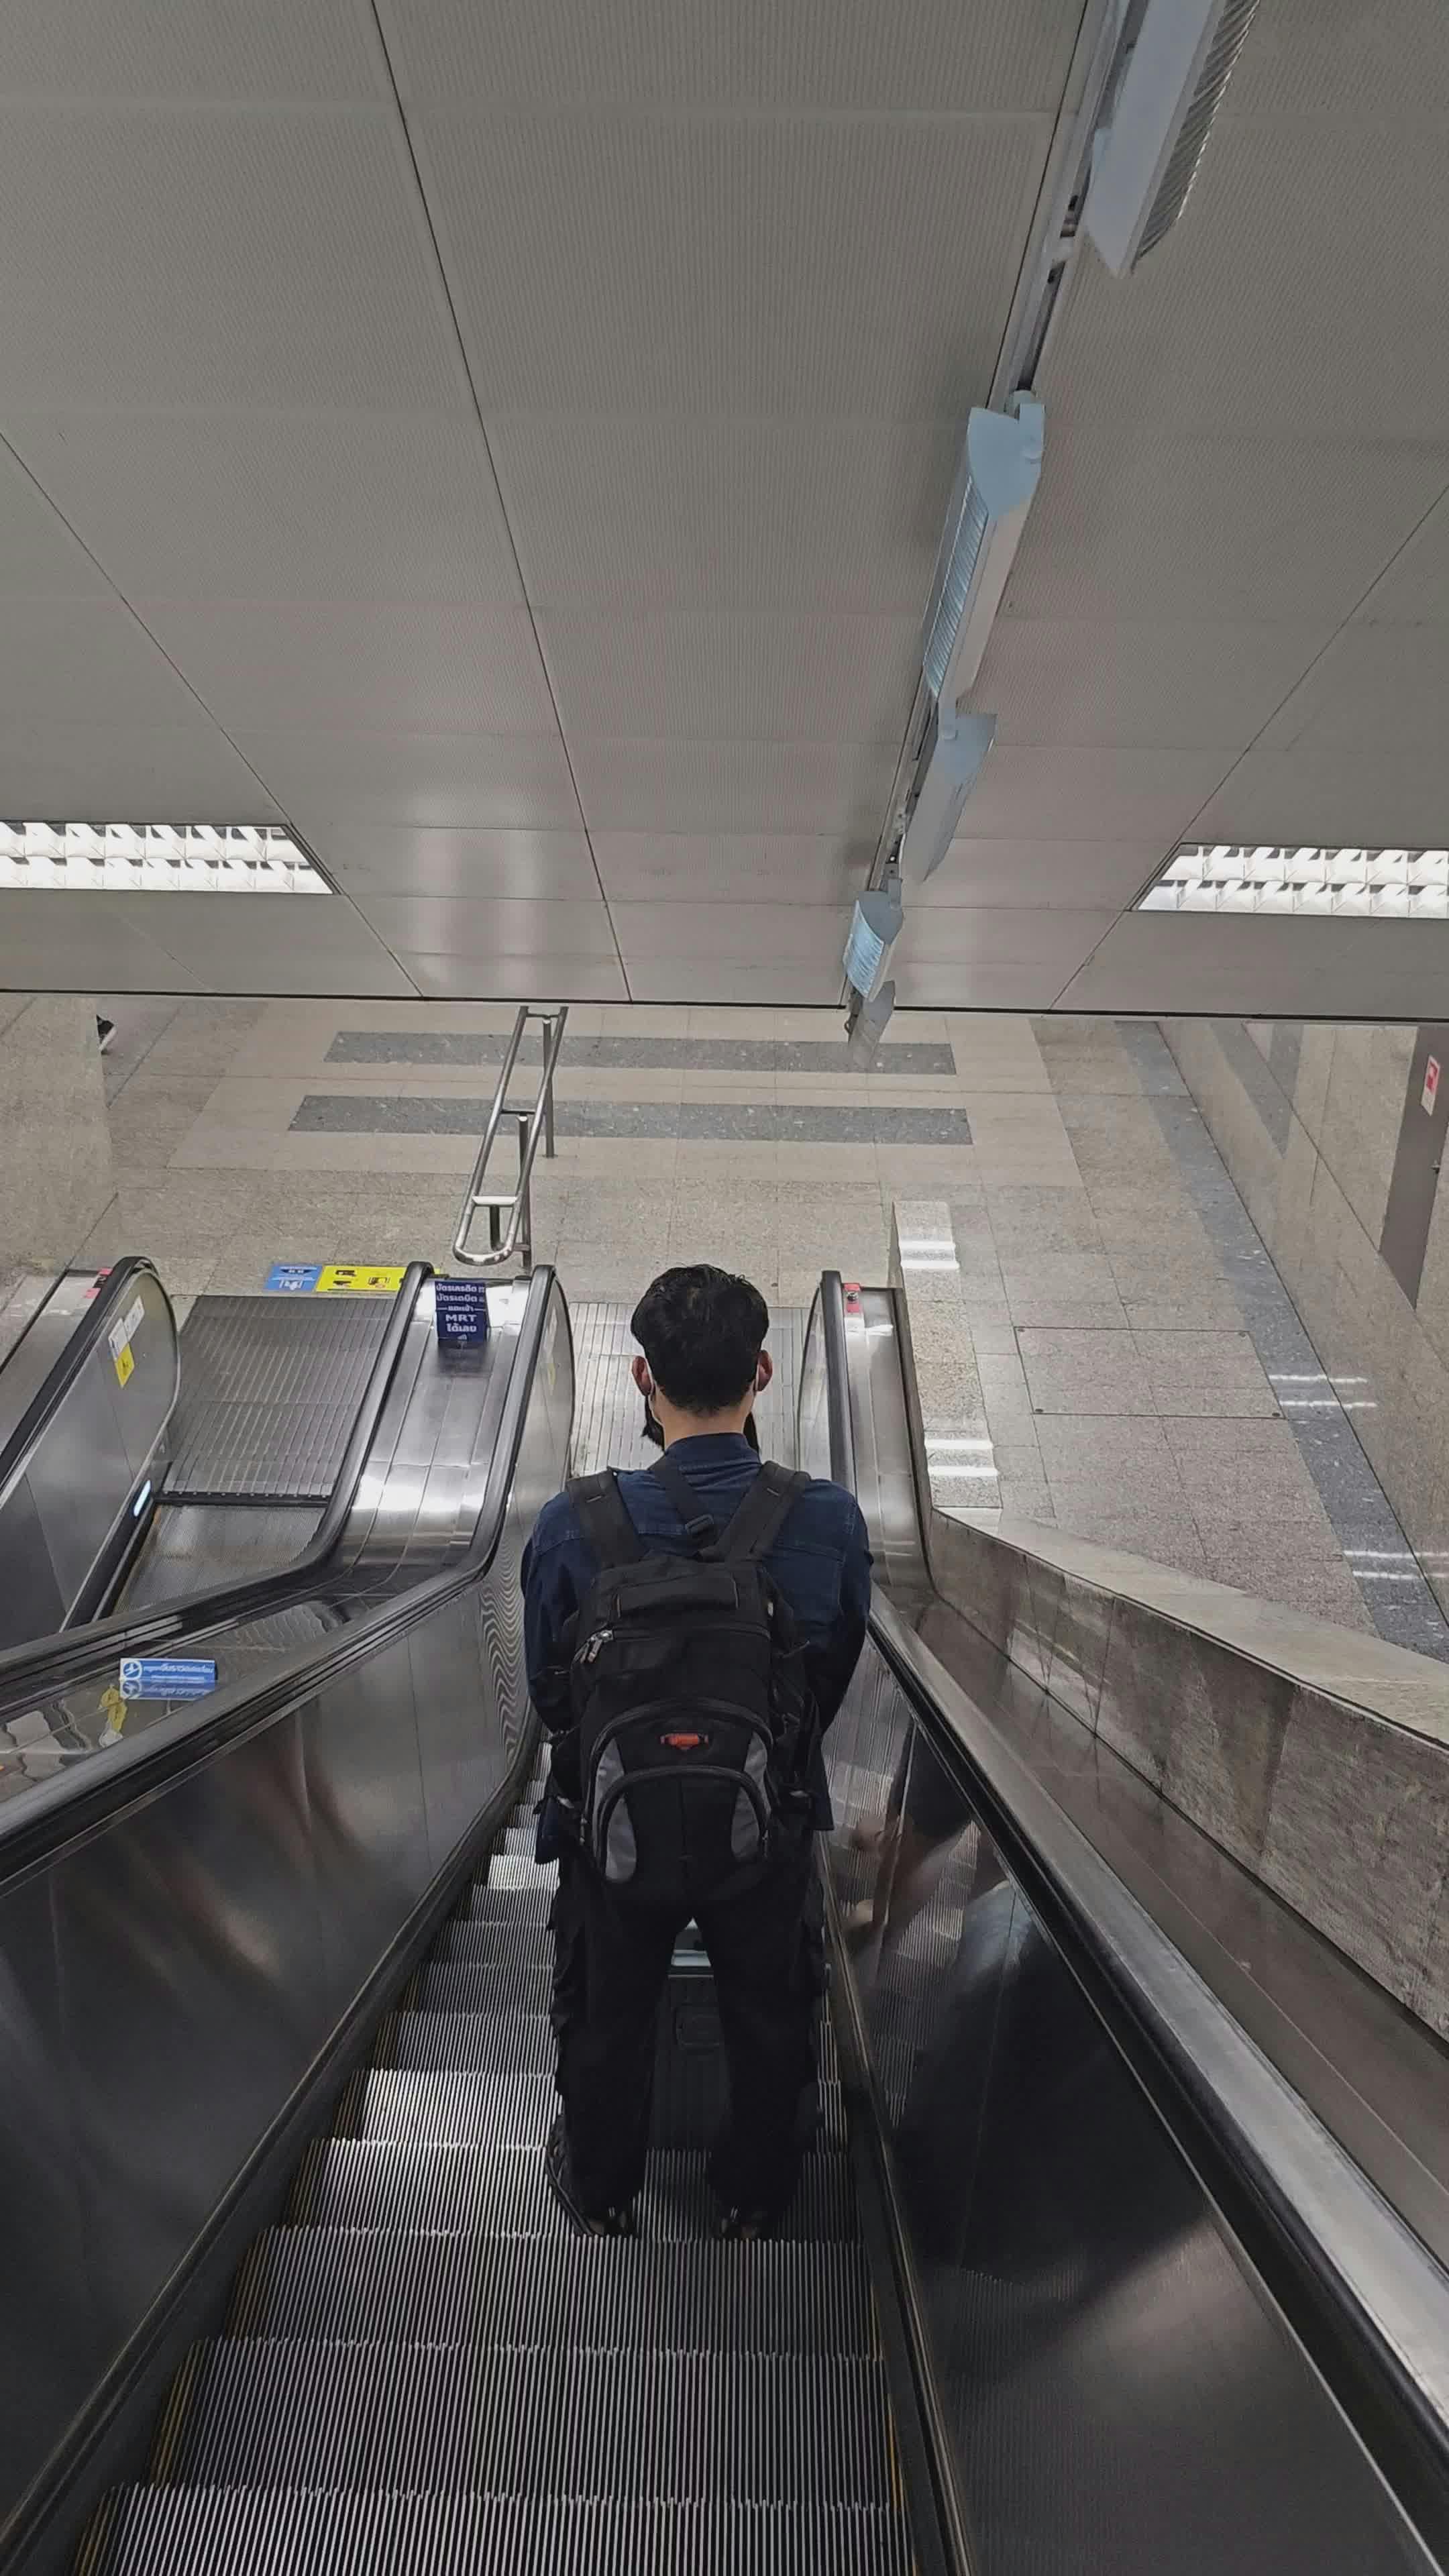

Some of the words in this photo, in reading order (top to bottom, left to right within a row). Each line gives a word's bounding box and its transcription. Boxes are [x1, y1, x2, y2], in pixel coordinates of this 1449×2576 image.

[445, 1314, 477, 1322] MRT
[447, 1323, 477, 1332] ได้เลย
